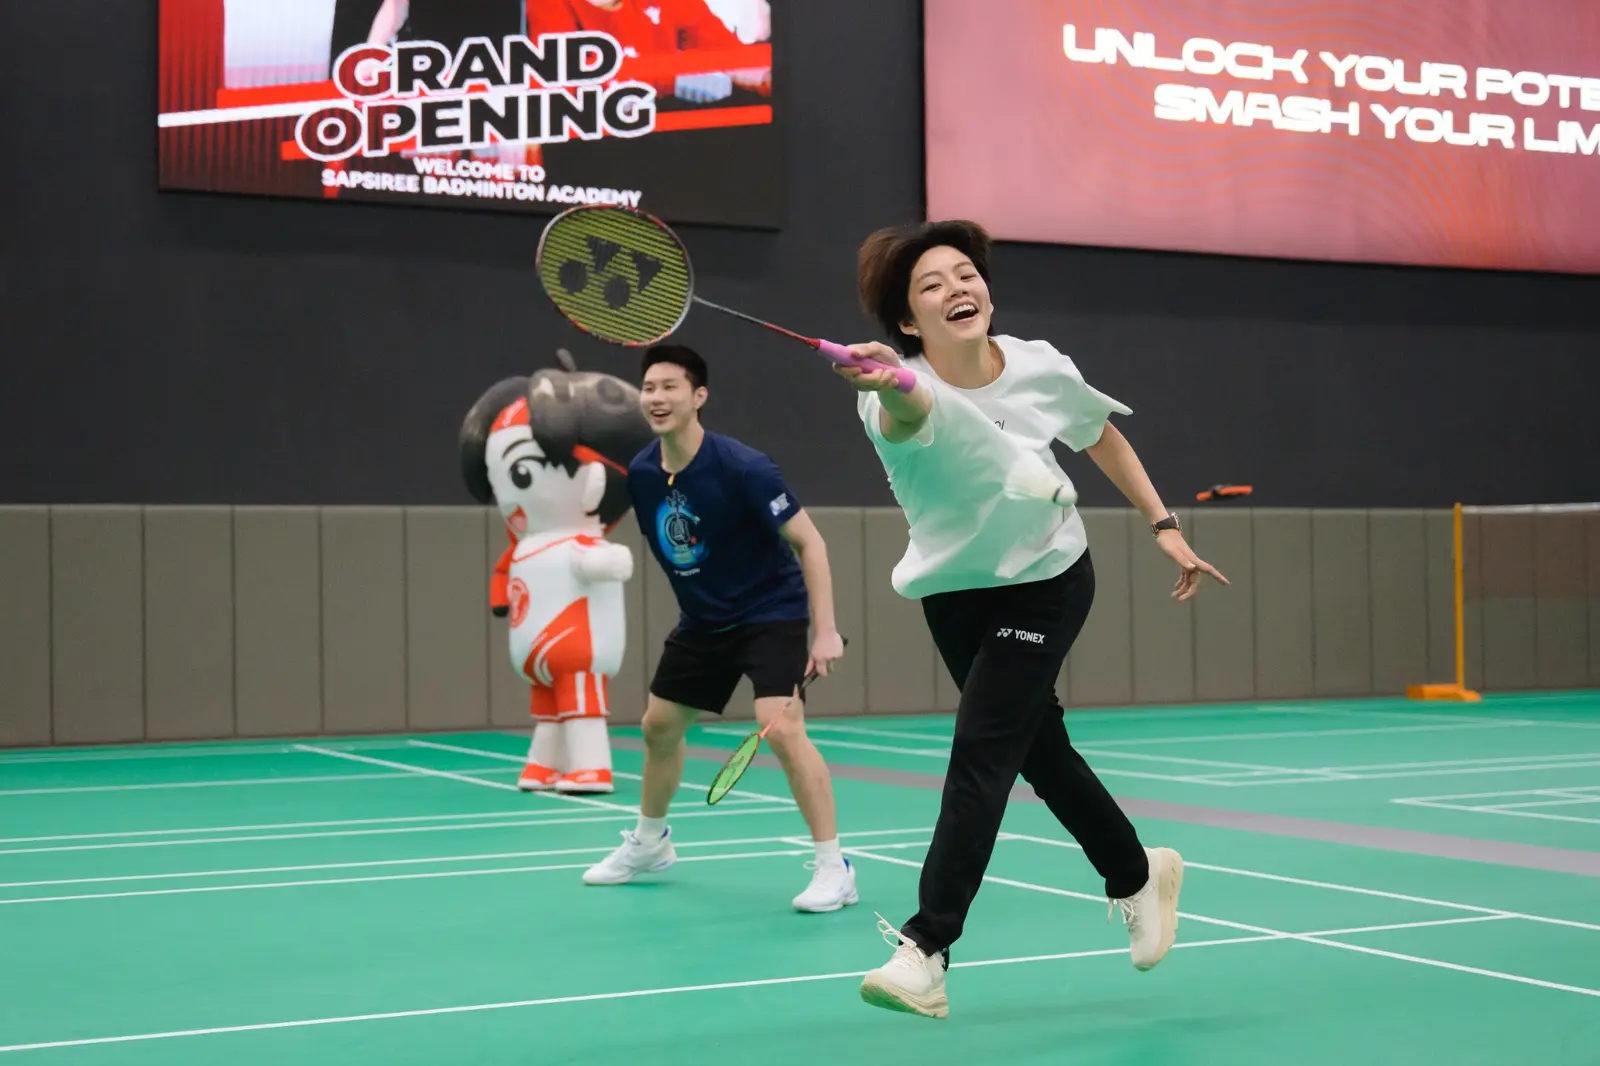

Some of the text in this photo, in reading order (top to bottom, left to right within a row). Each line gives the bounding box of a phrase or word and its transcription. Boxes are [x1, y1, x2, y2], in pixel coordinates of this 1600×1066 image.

[333, 31, 623, 99] GRAND
[1062, 23, 1309, 84] UNLOCK
[1320, 51, 1467, 99] YOUR
[295, 80, 657, 162] OPENING
[1154, 83, 1600, 155] SMASH YOUR LIM
[321, 168, 642, 208] SAPSIREE BADMINTON ACADEMY
[413, 157, 546, 183] WELCOME TO
[1015, 629, 1045, 644] YONEX
